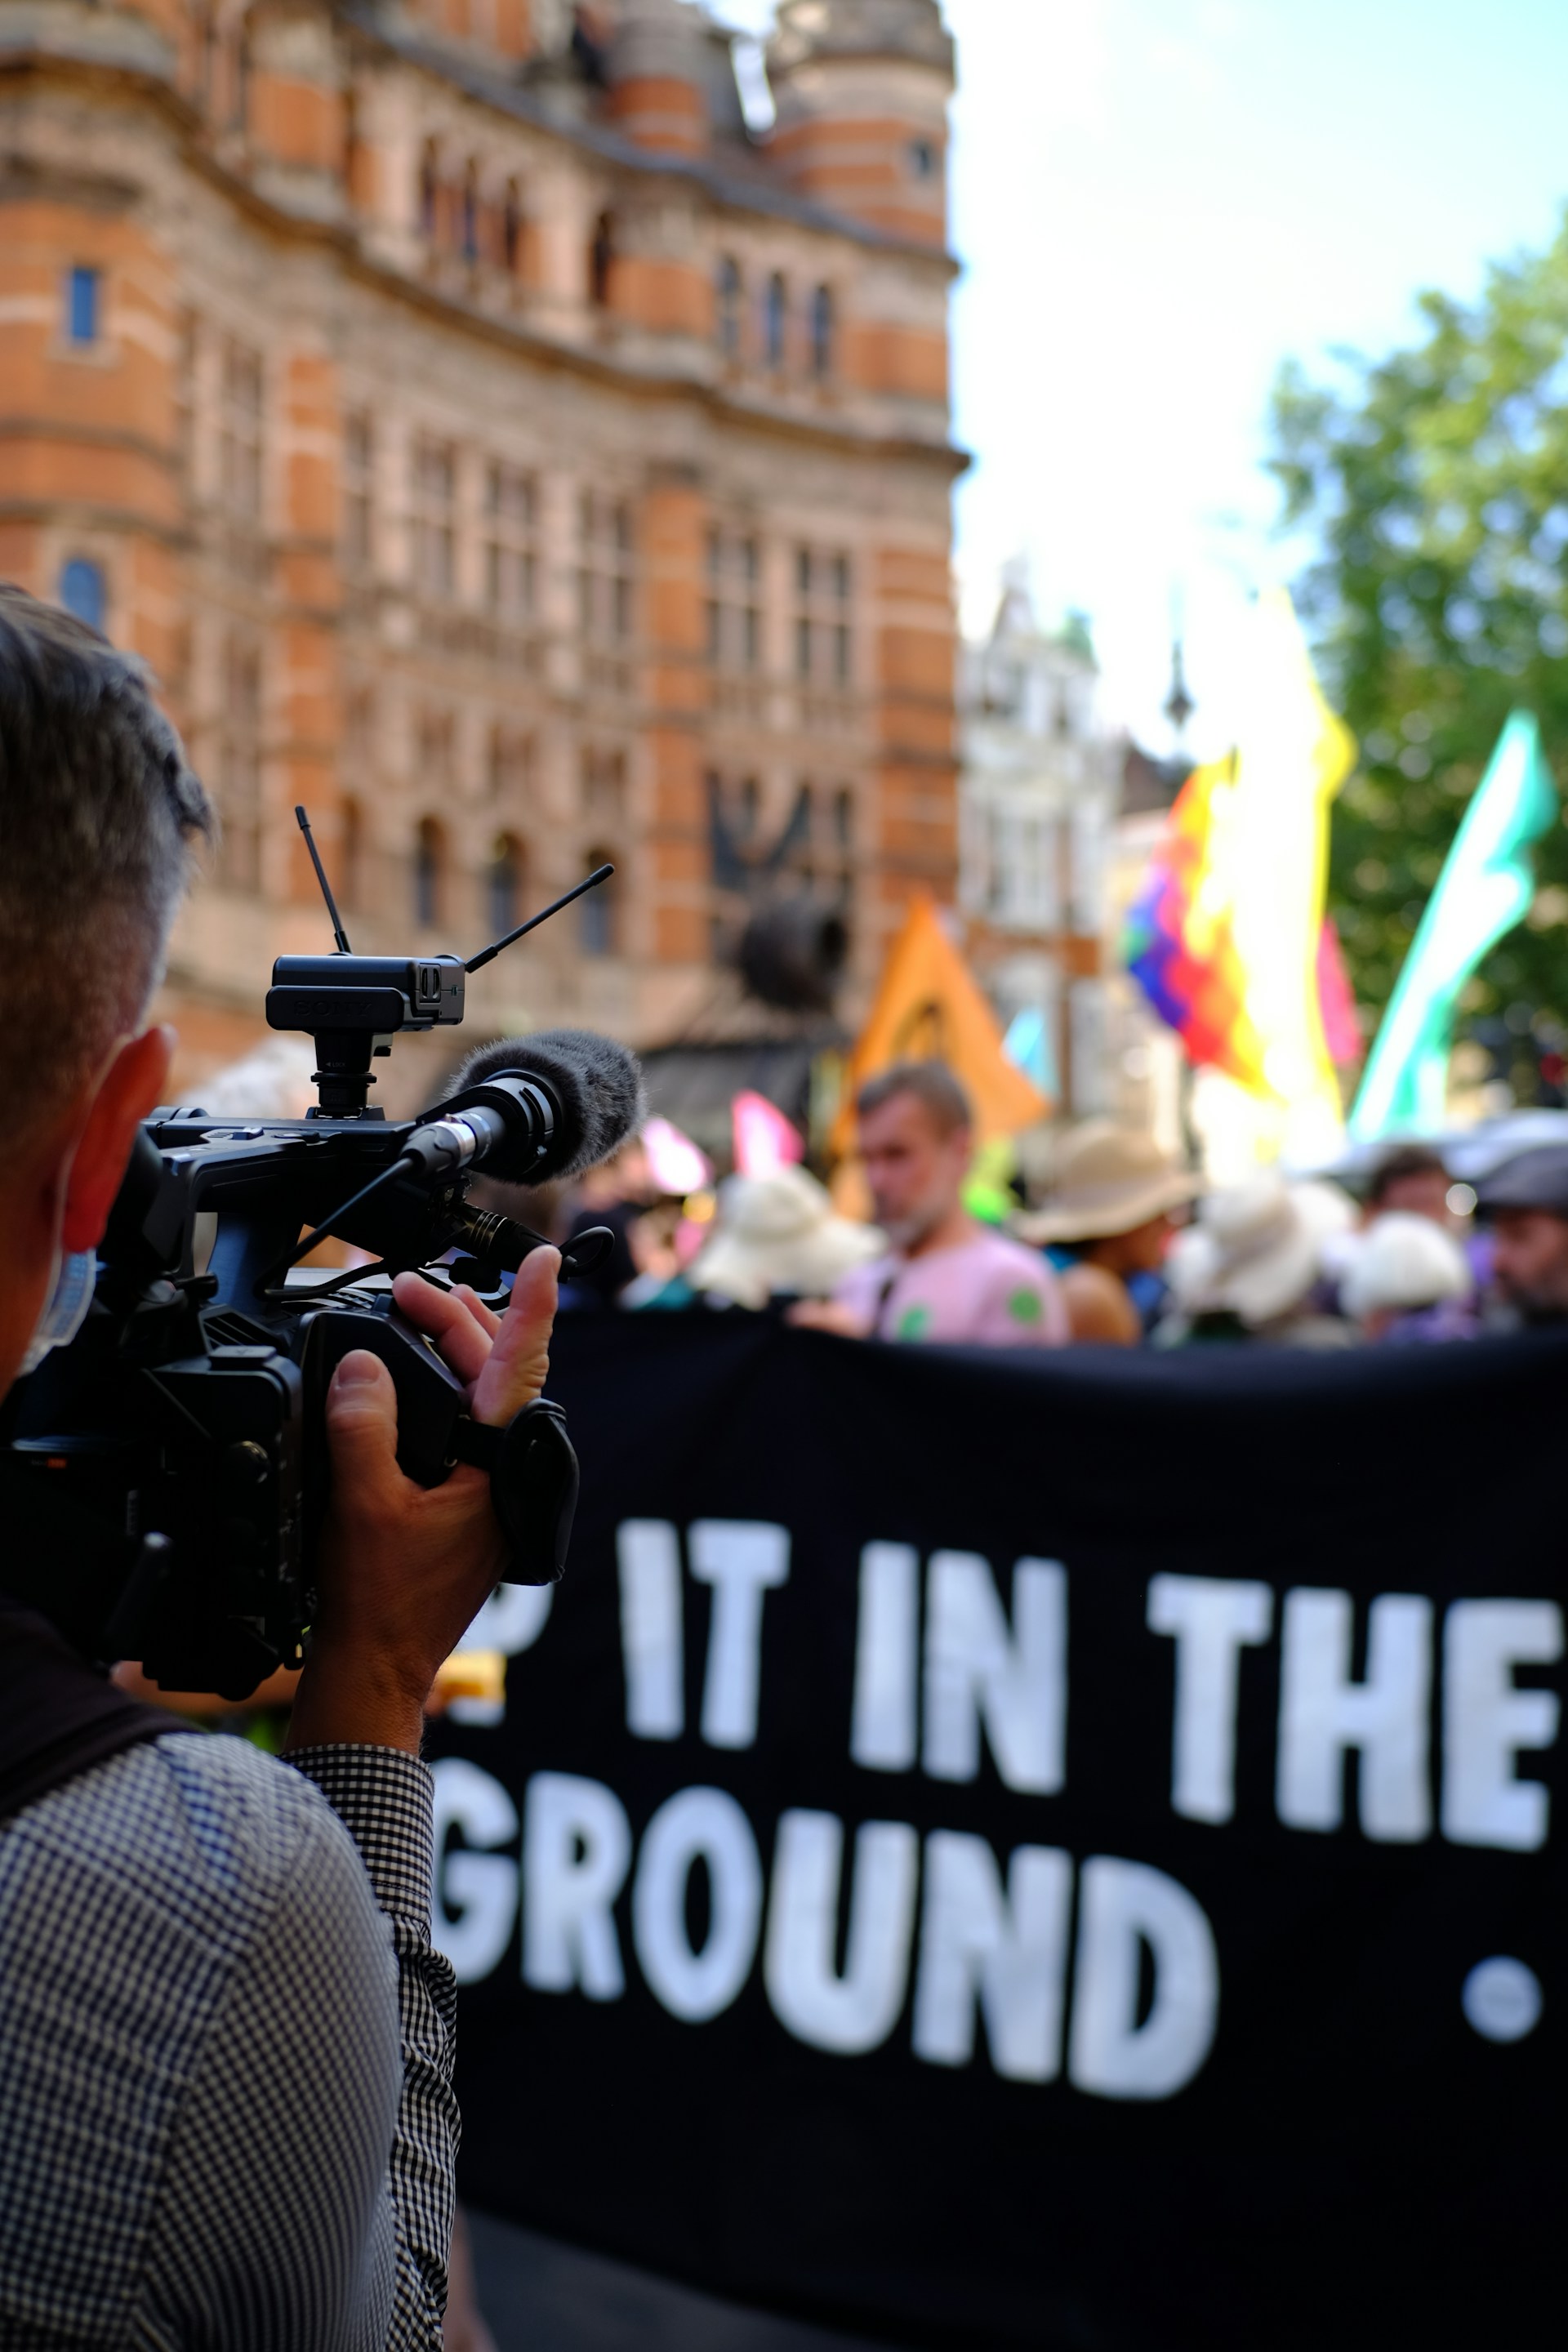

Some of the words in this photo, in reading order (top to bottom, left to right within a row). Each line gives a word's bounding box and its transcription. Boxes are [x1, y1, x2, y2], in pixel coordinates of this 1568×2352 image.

[293, 1000, 372, 1018] SONY
[618, 1520, 789, 1747] IT
[853, 1542, 1066, 1793] IN
[1147, 1575, 1563, 1850] THE
[431, 1760, 1217, 2096] GROUND
